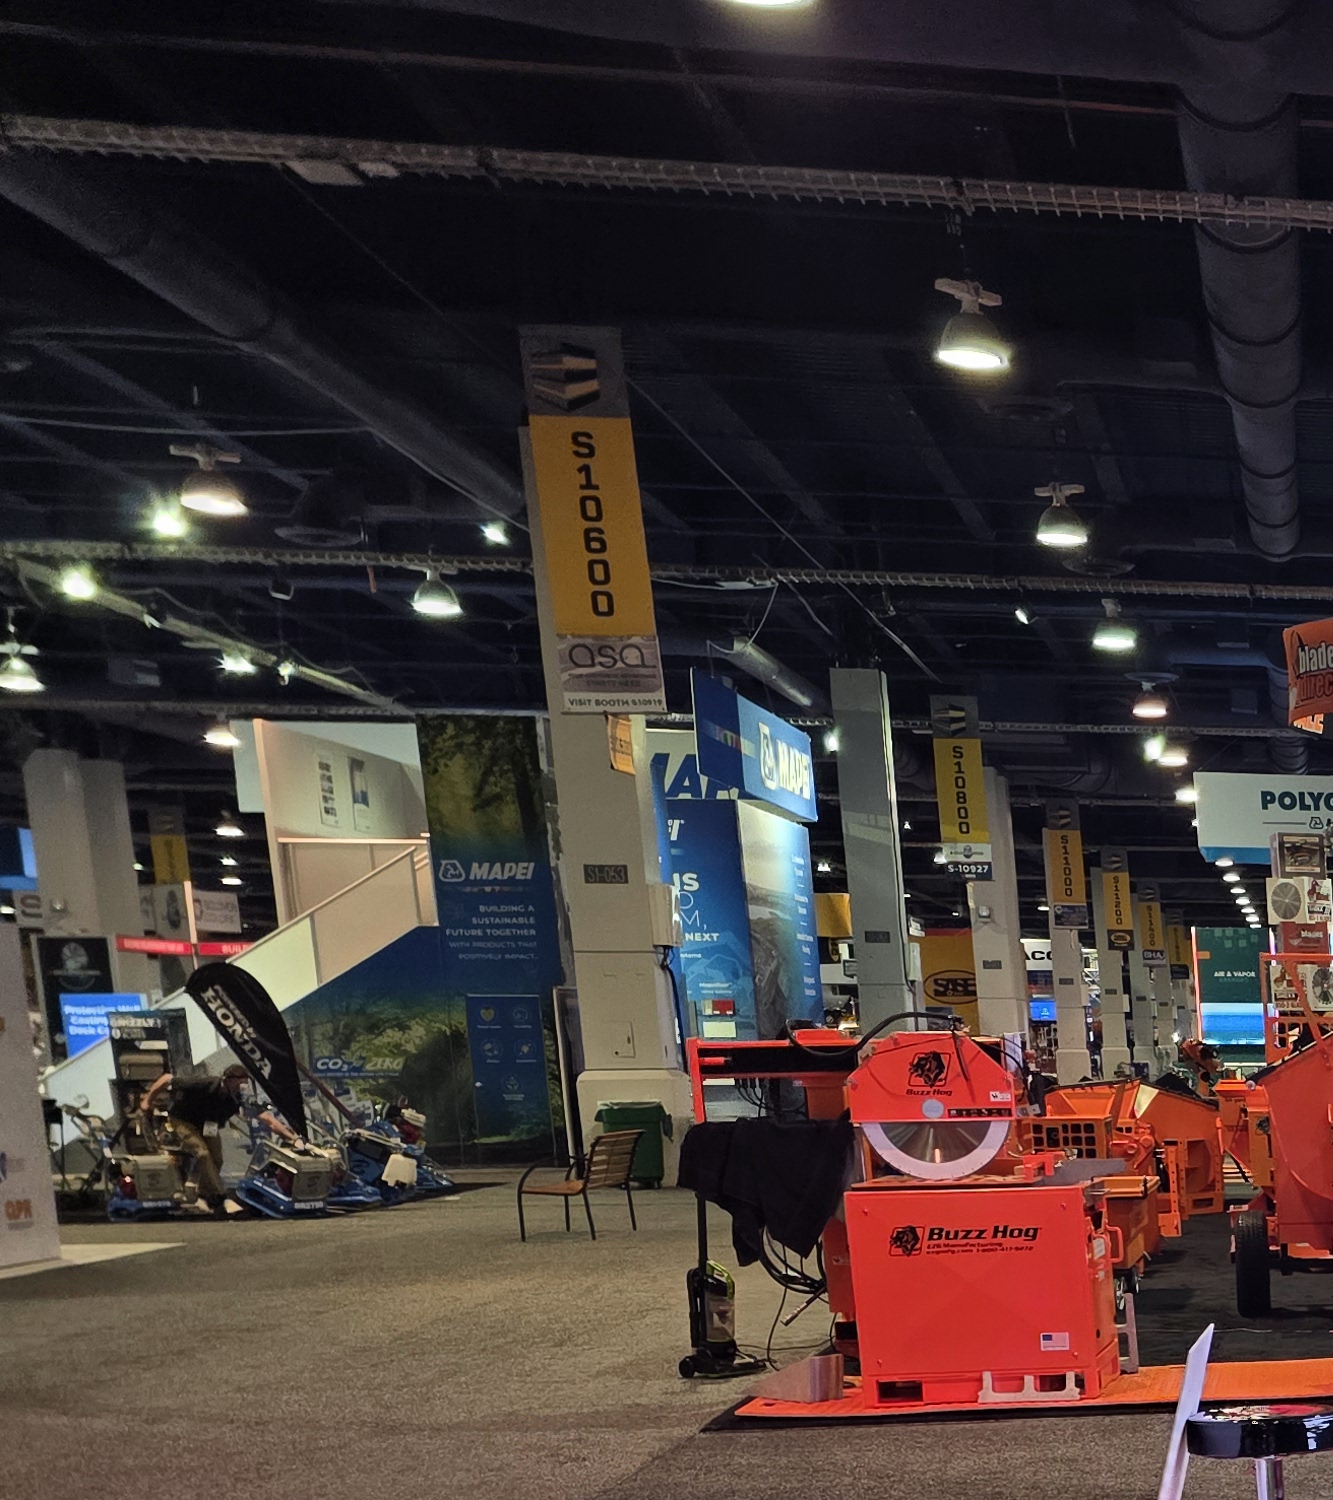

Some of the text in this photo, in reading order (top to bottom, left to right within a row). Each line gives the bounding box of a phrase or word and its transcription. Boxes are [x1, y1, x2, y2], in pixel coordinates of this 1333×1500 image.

[571, 430, 615, 618] S10600
[568, 698, 591, 706] VISIT
[595, 698, 629, 707] BOOTH
[952, 745, 971, 835] S10800
[469, 862, 535, 880] MAPEI
[948, 864, 988, 873] S-10927
[1060, 835, 1073, 897] S11000
[587, 866, 625, 882] S1-053
[479, 904, 525, 913] BUILDING
[471, 916, 536, 924] SUSTAINABLE
[445, 928, 536, 936] FUTURE TOGETHER
[685, 932, 719, 942] NEXT
[201, 989, 272, 1080] HONDA
[906, 1088, 953, 1097] Buzz Hog
[927, 1225, 1039, 1241] Buzz Hog
